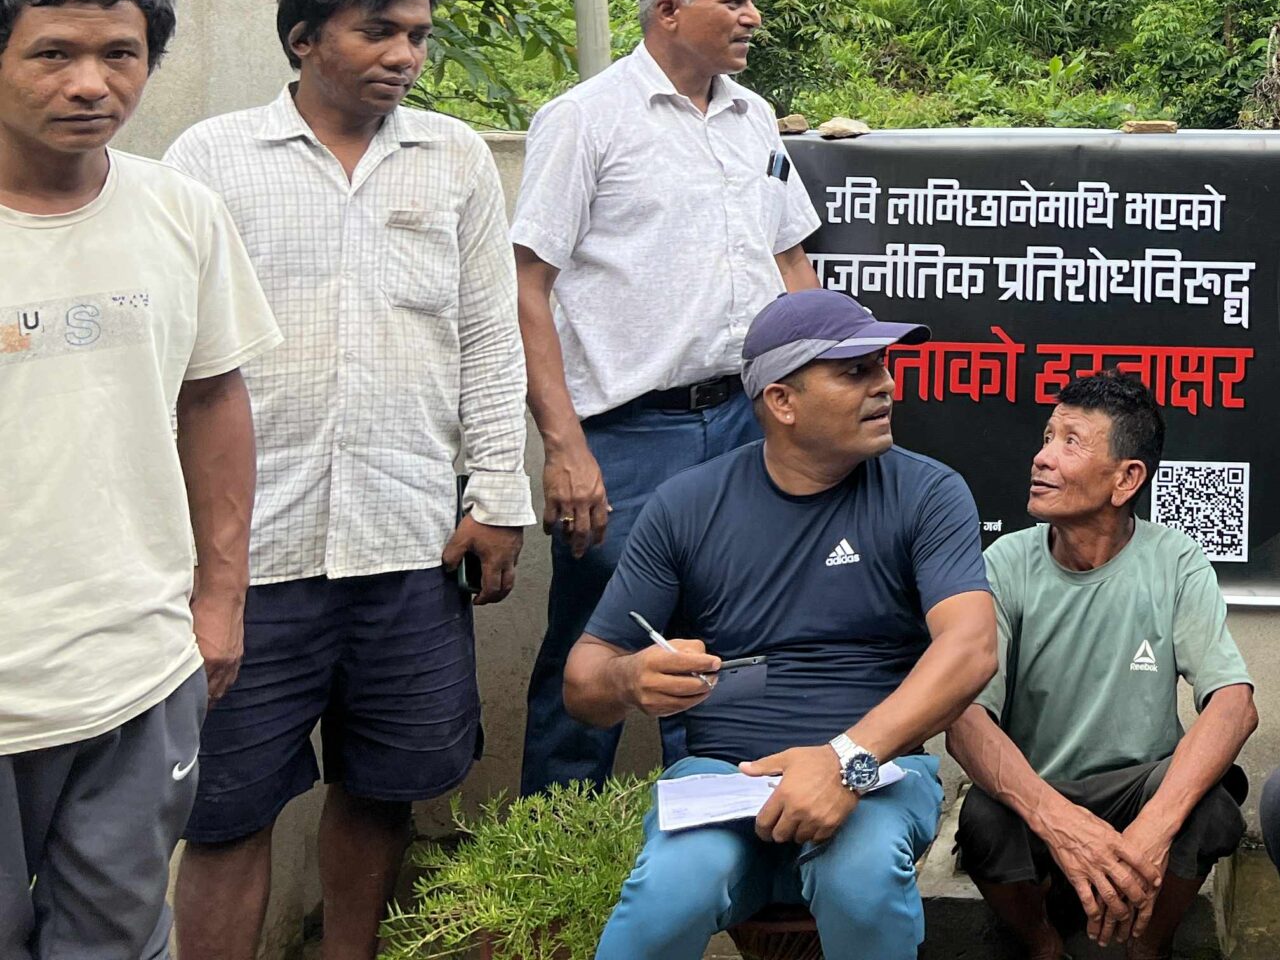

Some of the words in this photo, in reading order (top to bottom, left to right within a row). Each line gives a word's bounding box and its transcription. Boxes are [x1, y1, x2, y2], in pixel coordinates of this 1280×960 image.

[826, 176, 881, 224] रवि
[887, 178, 1119, 229] लामिछानेमाथि
[1125, 184, 1226, 231] भएको
[806, 243, 990, 299] ाजनीतिक
[884, 326, 1025, 403] ताको
[825, 553, 860, 567] adidas
[1130, 662, 1158, 673] Reebok
